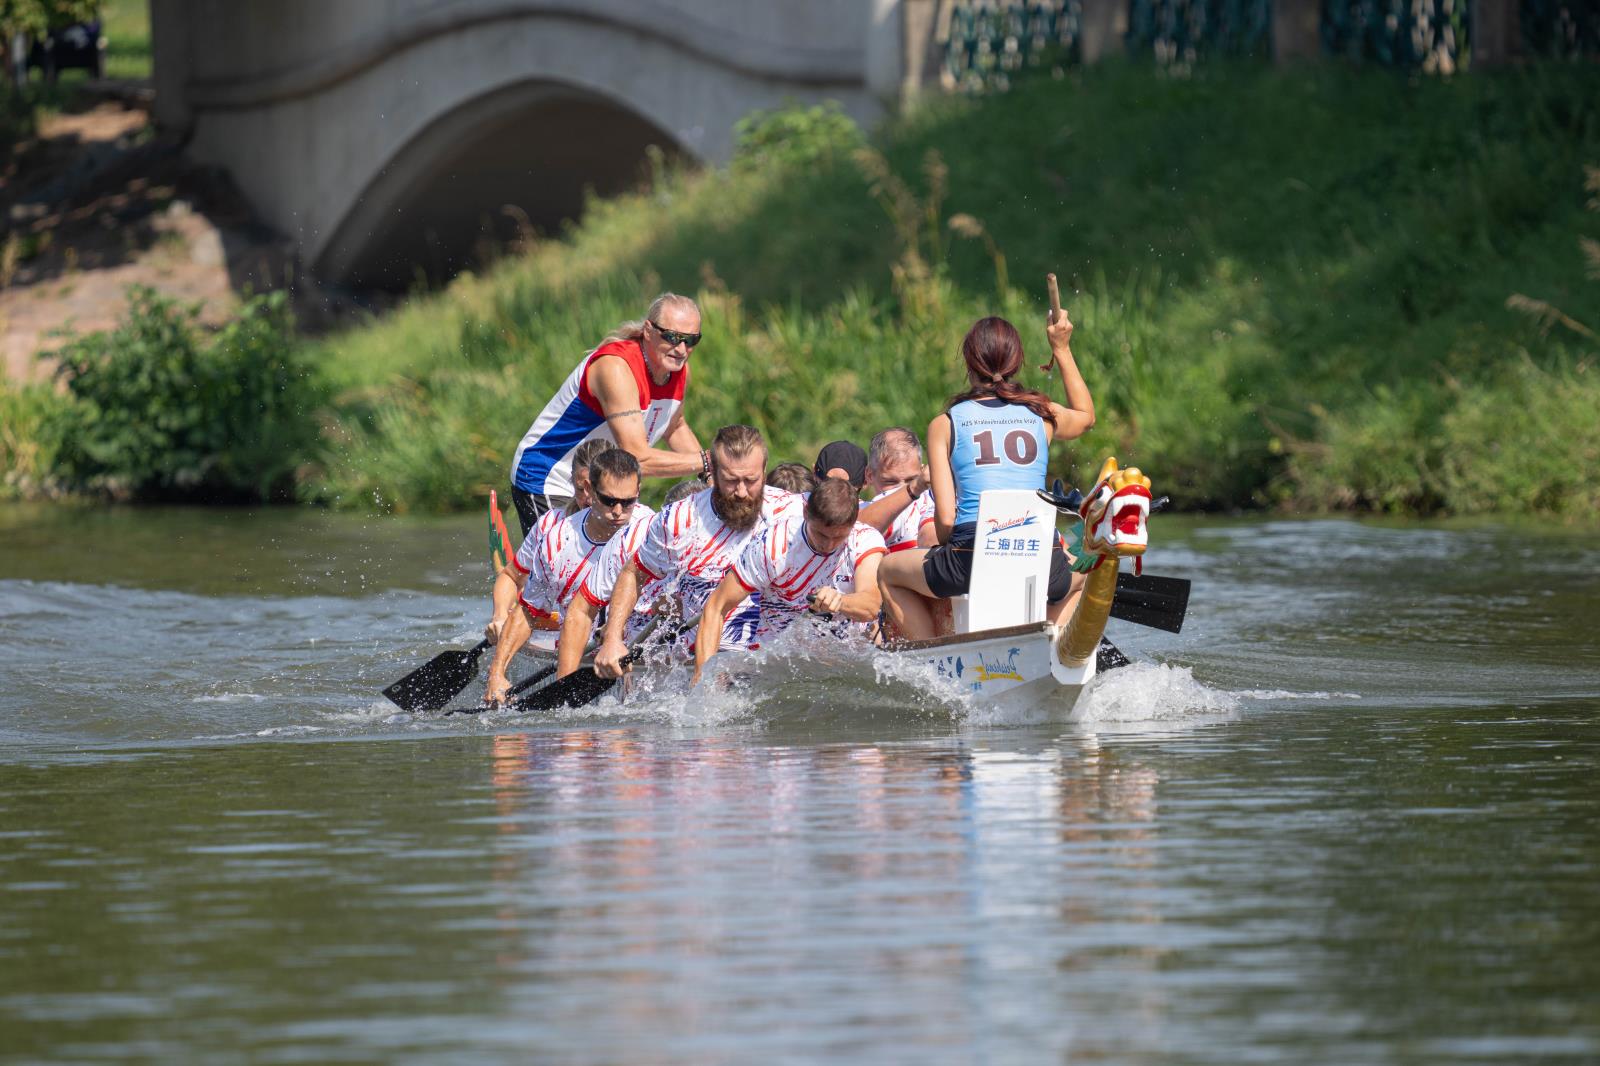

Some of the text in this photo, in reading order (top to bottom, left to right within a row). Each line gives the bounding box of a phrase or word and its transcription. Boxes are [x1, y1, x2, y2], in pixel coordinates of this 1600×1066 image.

[973, 430, 1038, 466] 10
[984, 538, 1041, 551] 上海培生
